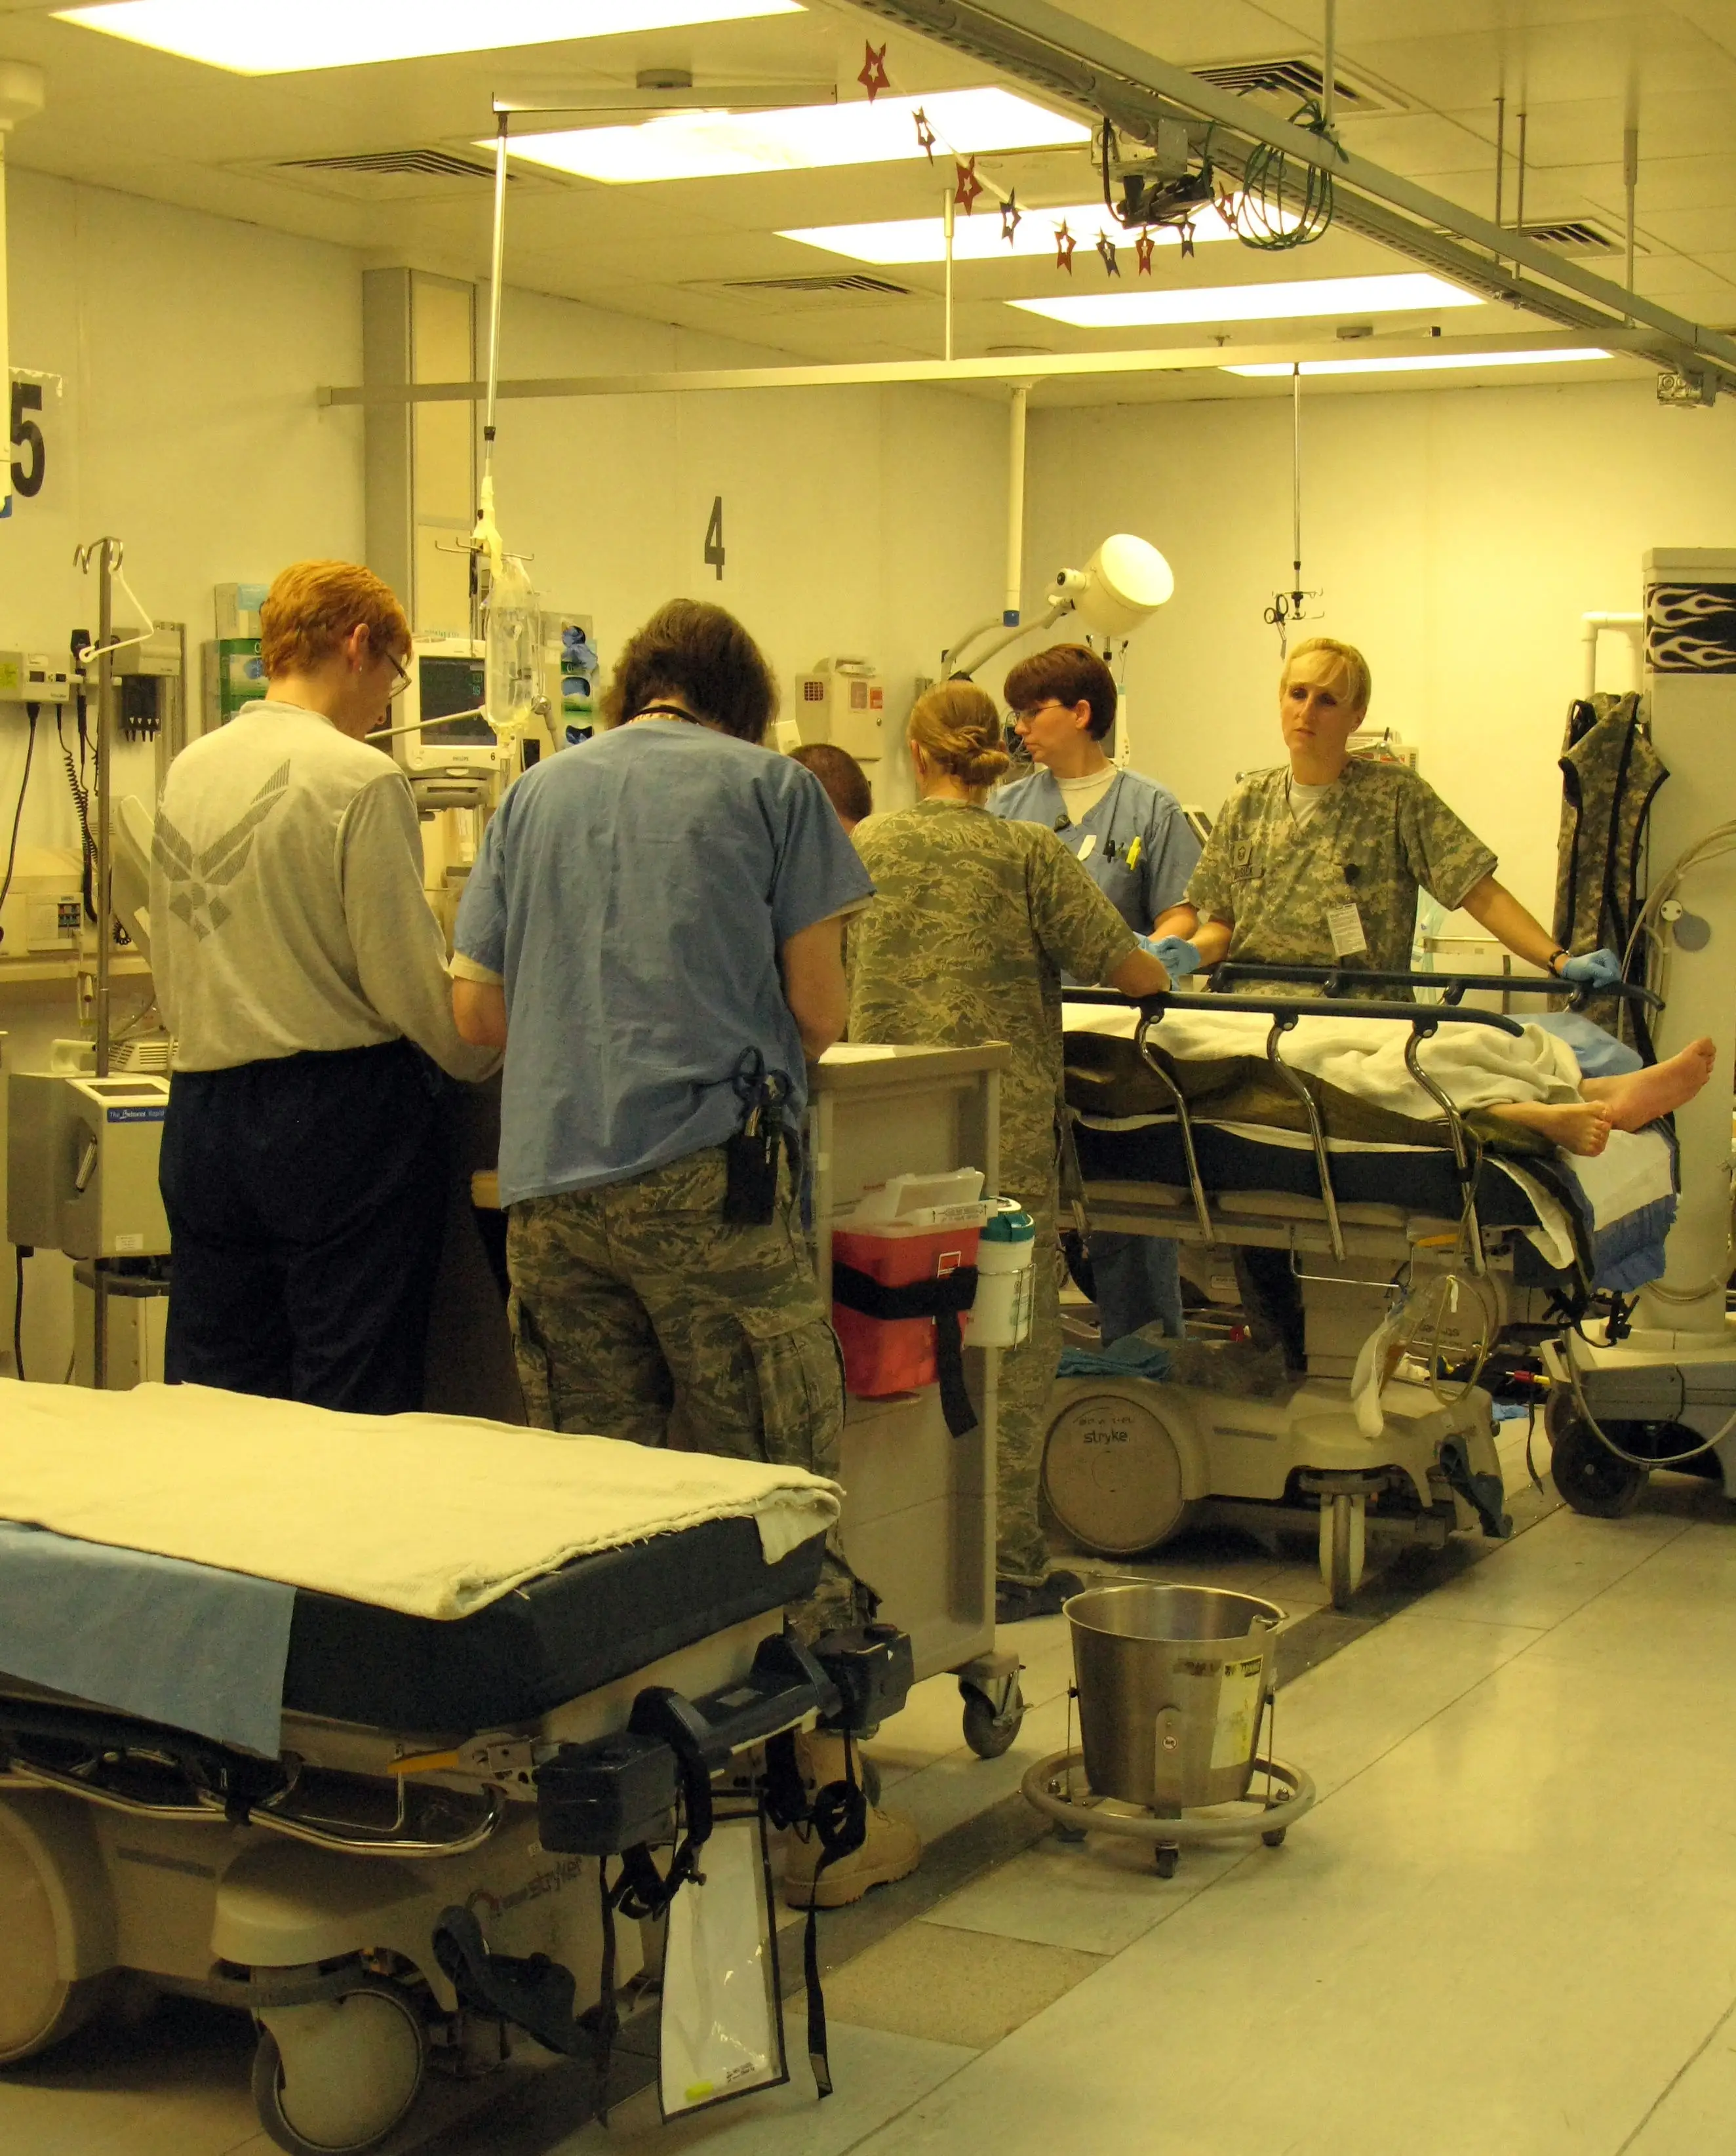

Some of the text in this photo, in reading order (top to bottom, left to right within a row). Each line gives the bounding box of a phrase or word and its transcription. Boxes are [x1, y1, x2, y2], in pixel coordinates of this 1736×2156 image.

[10, 381, 45, 498] 5
[704, 496, 725, 581] 4
[490, 752, 496, 761] 6
